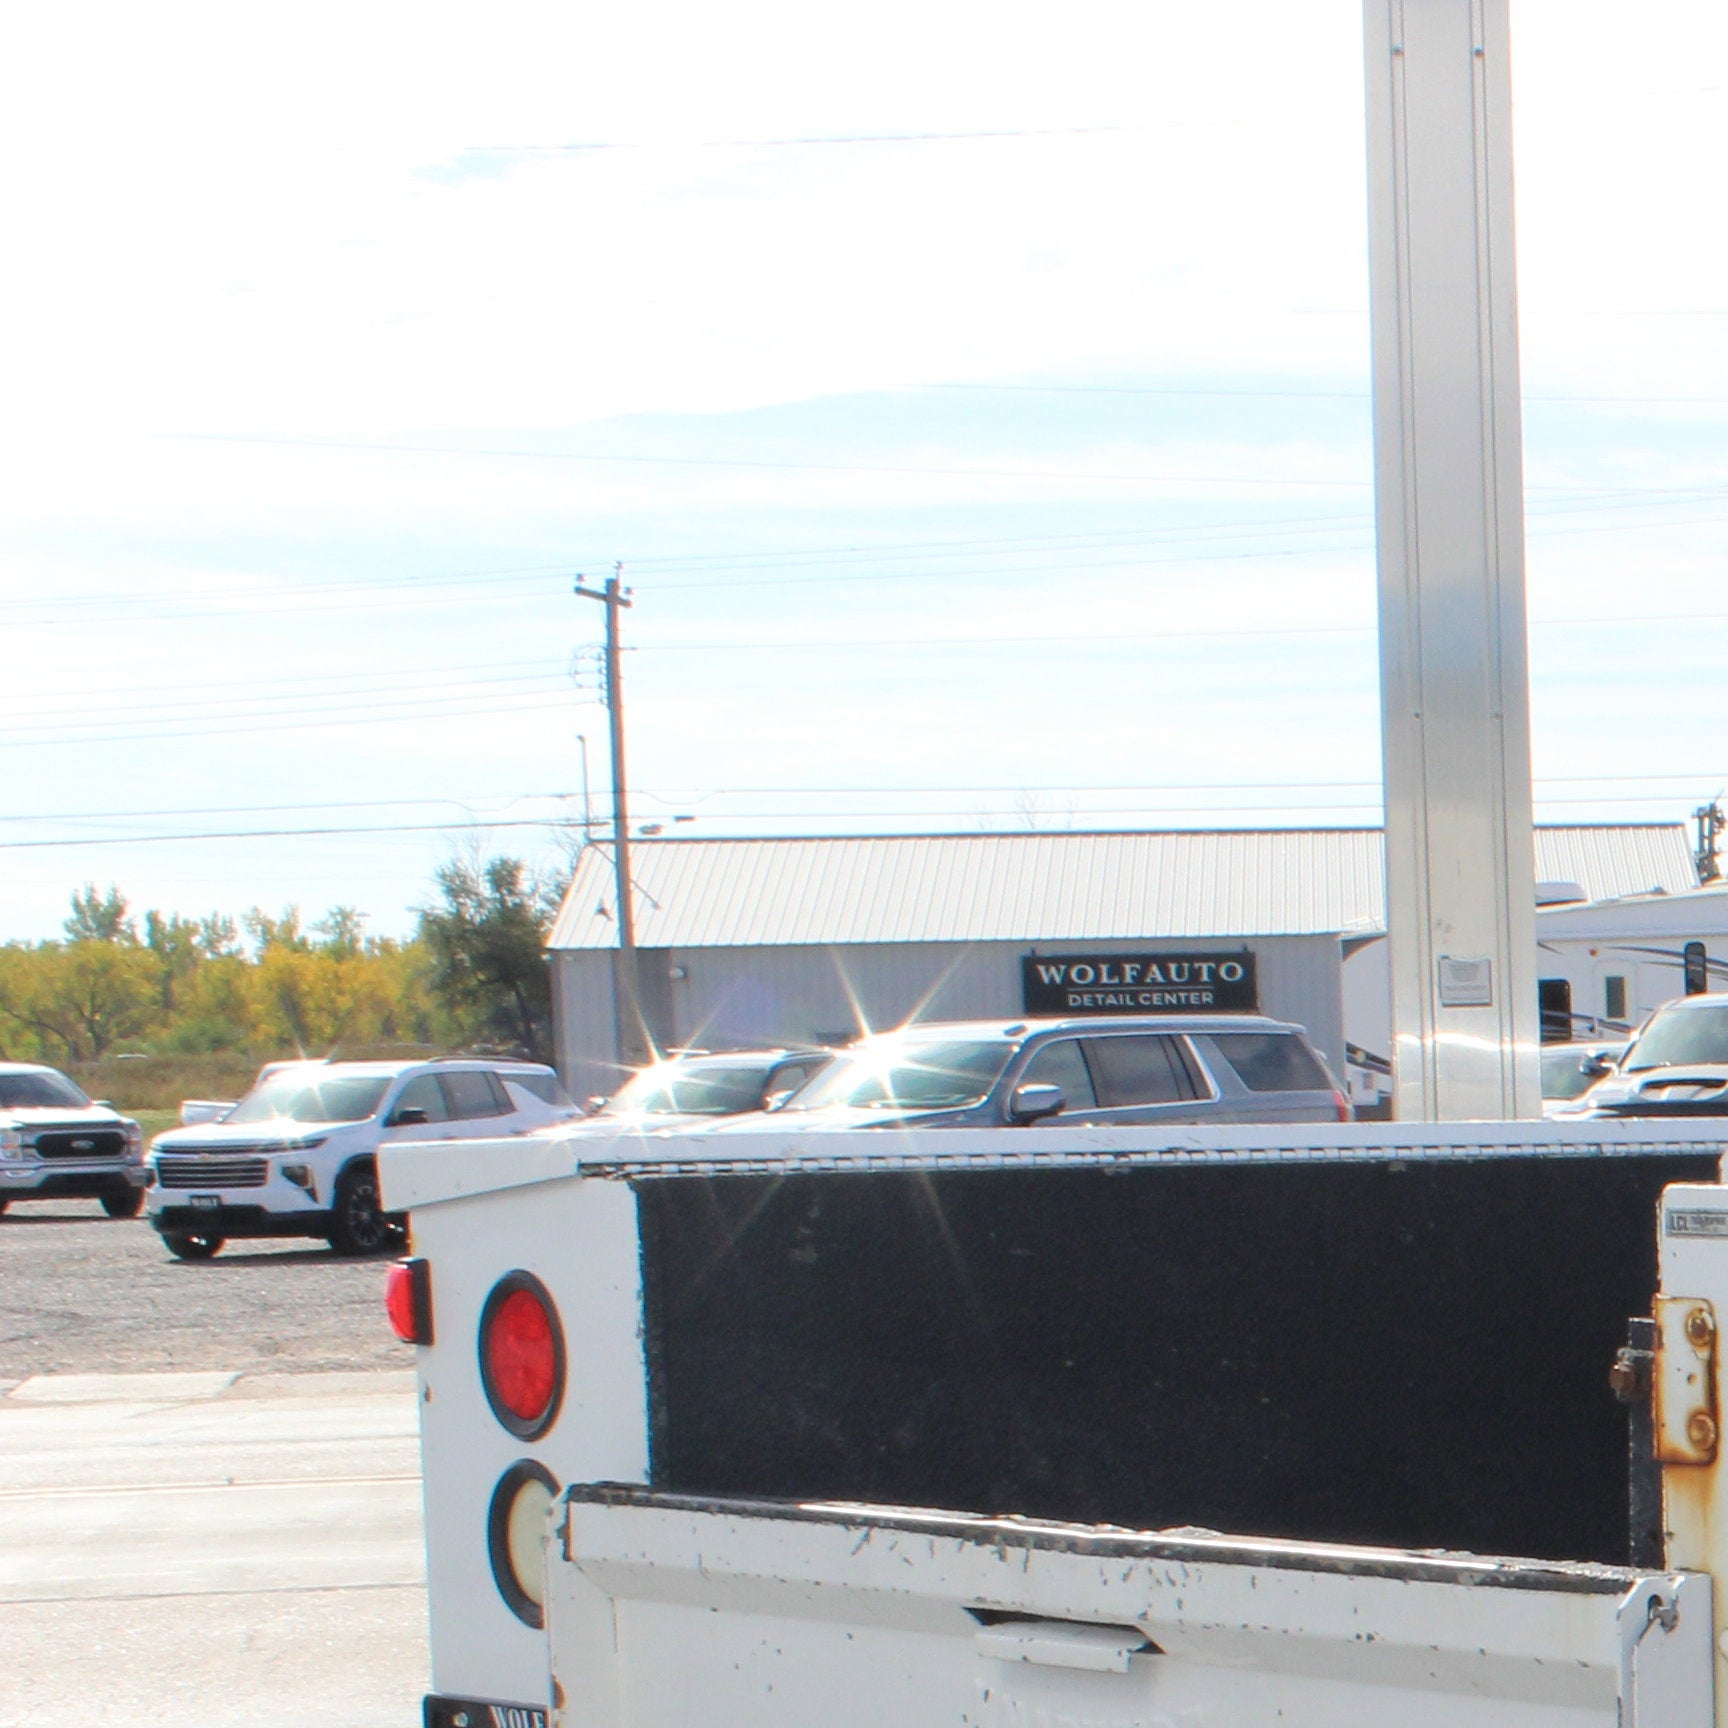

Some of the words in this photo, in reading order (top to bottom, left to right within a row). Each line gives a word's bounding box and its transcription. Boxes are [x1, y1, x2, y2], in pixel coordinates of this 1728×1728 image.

[1036, 961, 1245, 986] WOLFAUTO
[1067, 993, 1135, 1008] DETAIL
[1138, 991, 1214, 1006] CENTER
